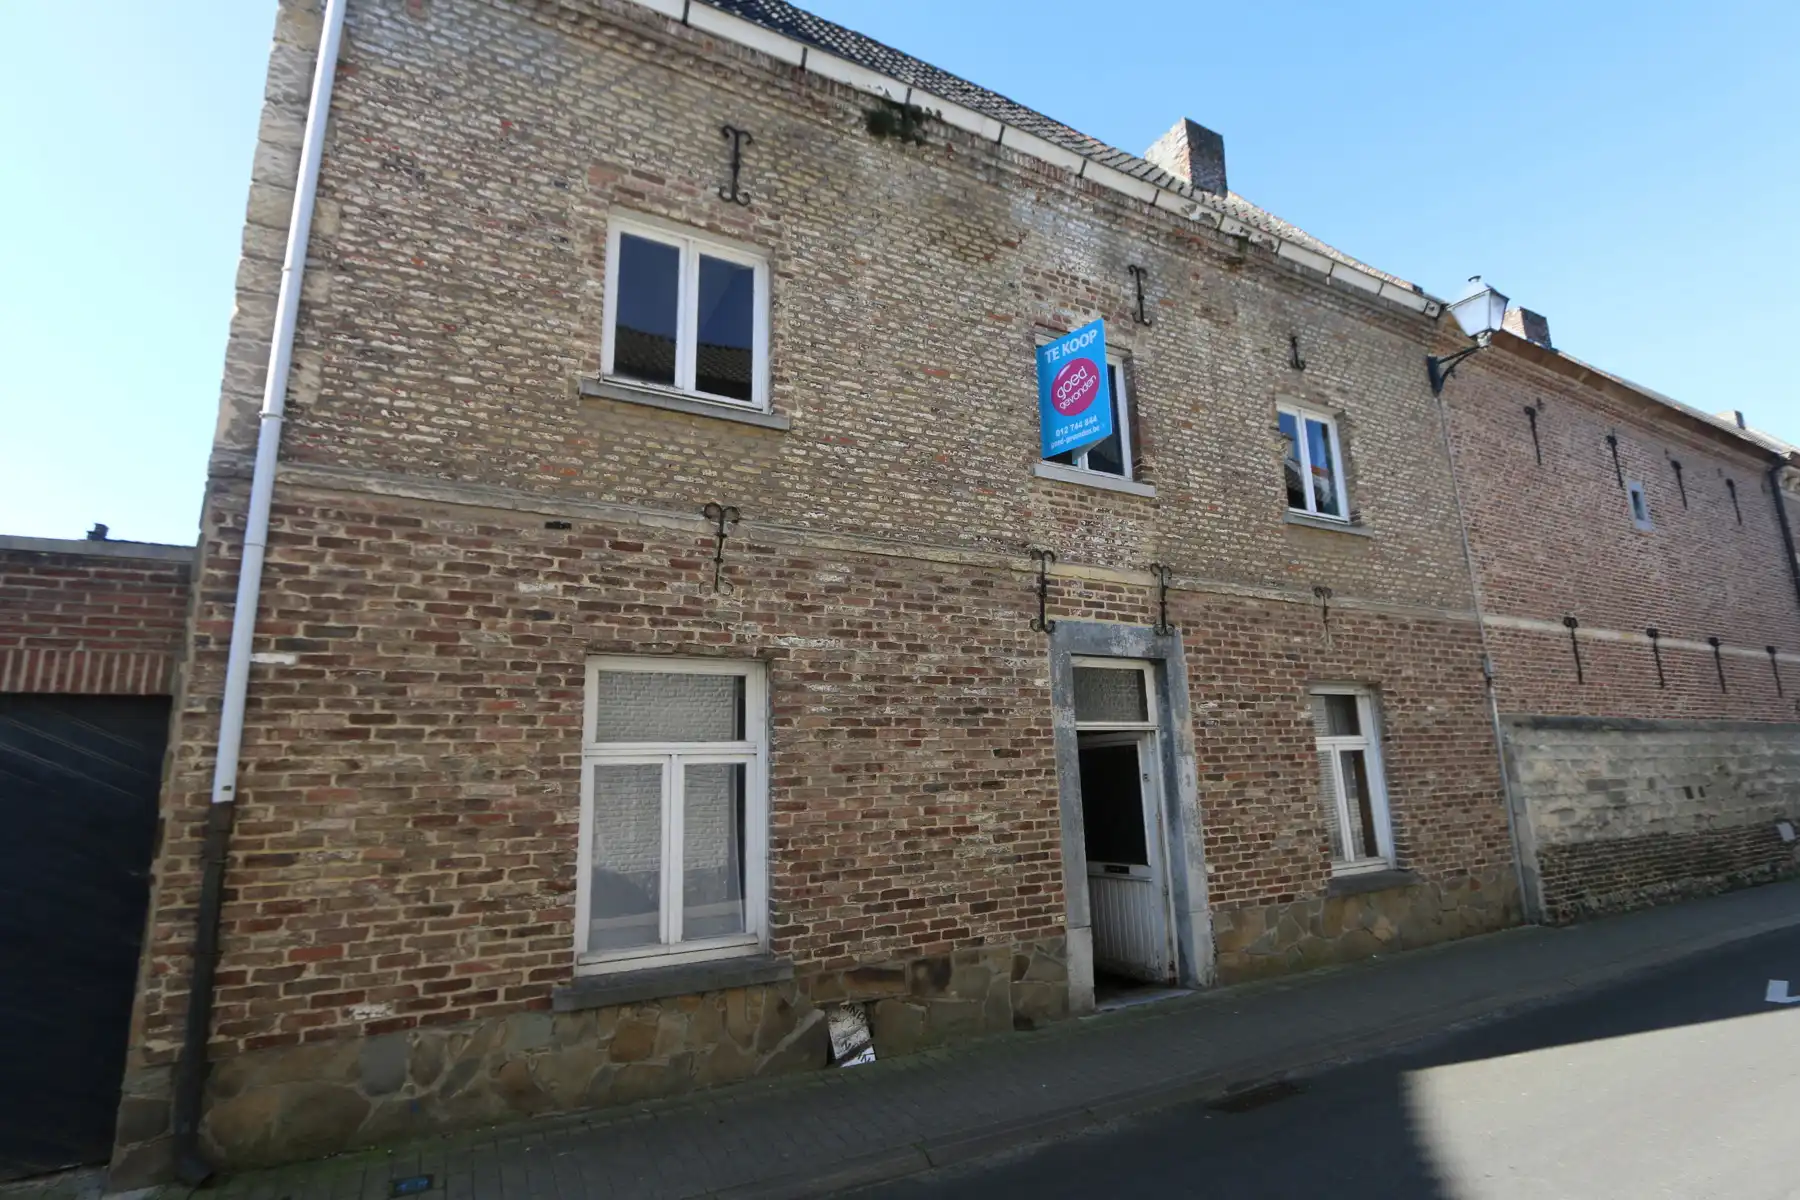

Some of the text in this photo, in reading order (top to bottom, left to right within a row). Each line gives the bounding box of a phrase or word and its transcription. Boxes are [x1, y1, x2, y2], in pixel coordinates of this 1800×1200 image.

[1044, 329, 1098, 364] TE KOOP
[1056, 365, 1087, 400] goed
[1059, 374, 1097, 410] gevonden
[1055, 426, 1069, 437] 012
